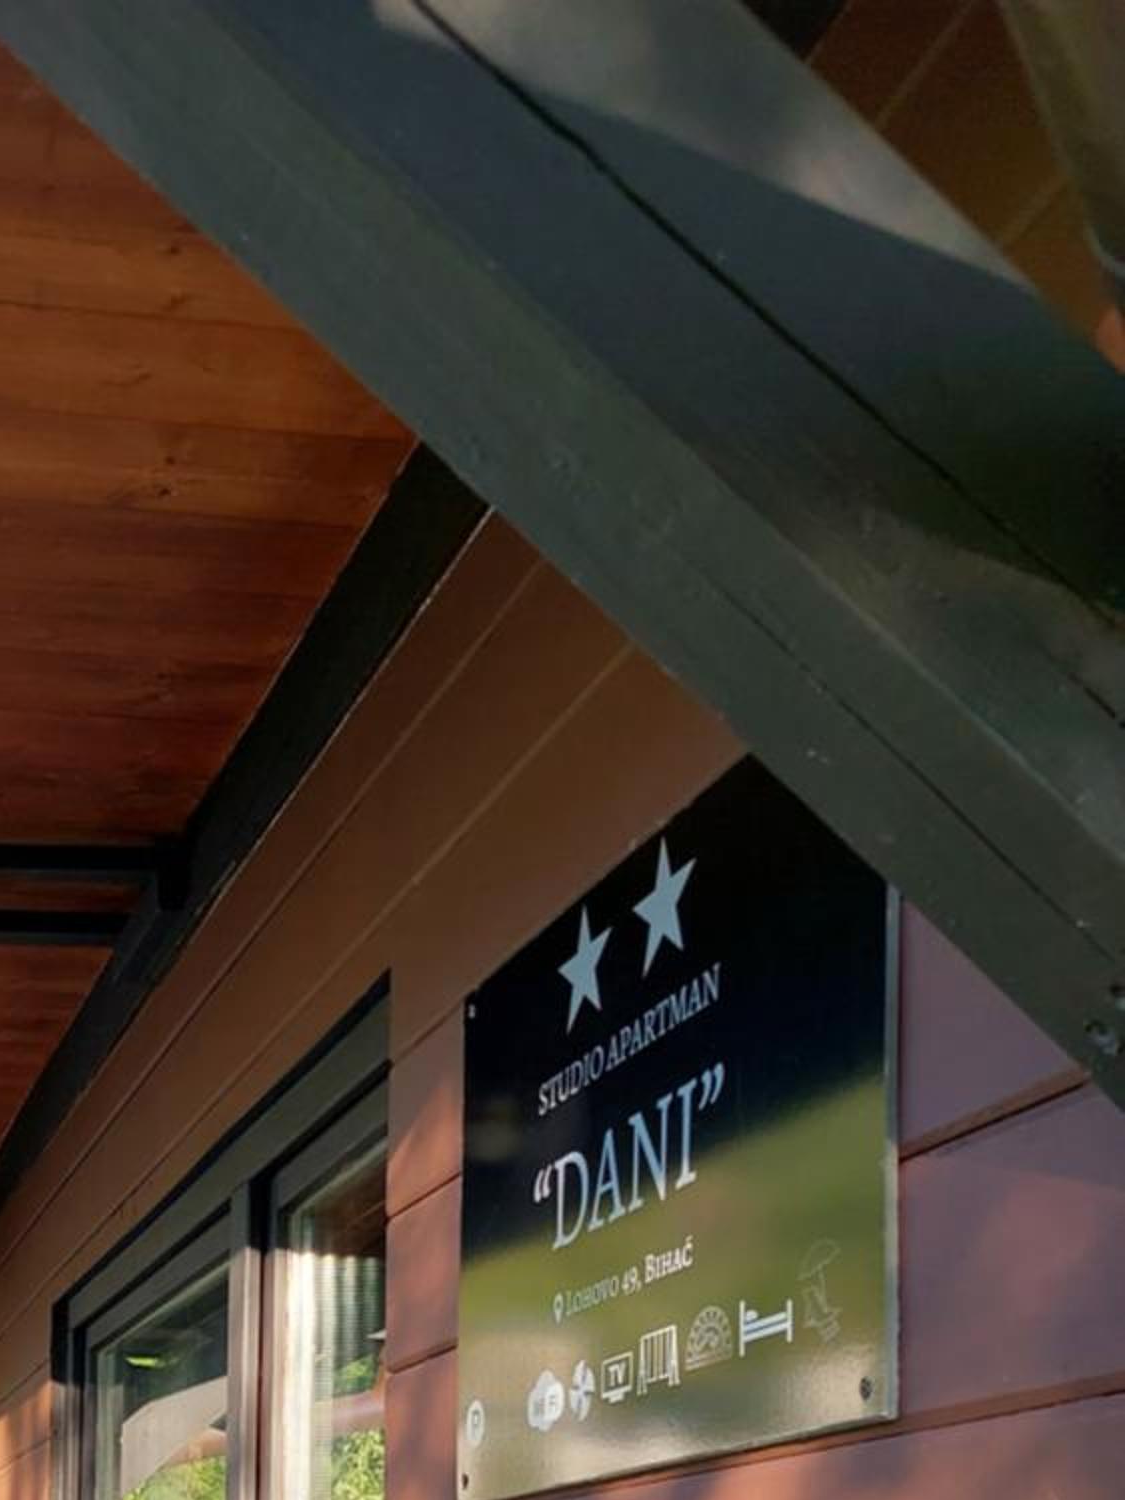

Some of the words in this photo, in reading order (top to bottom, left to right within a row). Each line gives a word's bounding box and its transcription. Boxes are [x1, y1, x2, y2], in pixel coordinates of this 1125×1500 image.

[537, 1044, 605, 1117] STUDIO
[605, 961, 722, 1073] APARTMAN
[607, 1362, 627, 1387] TV
